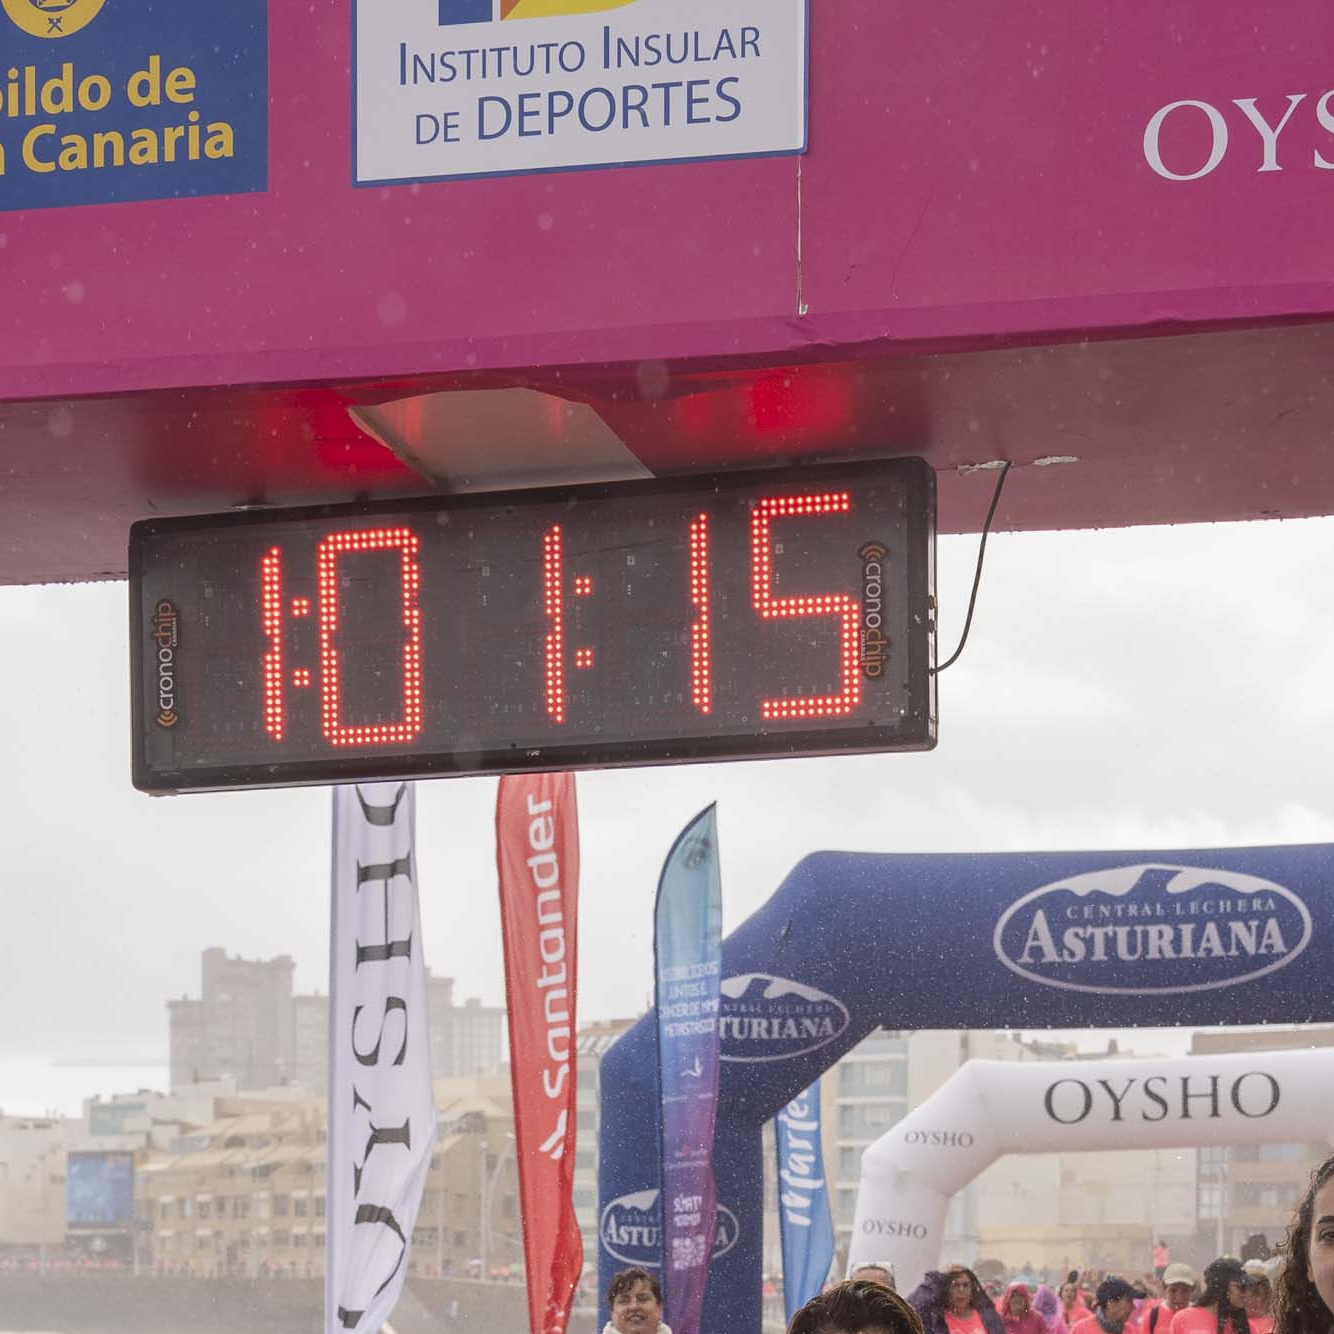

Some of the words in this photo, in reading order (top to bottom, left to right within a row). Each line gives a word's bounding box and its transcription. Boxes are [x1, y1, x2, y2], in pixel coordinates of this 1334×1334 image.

[127, 55, 196, 107] de
[400, 41, 585, 85] INSTITUTO
[603, 26, 761, 69] INSULAR
[415, 112, 460, 145] DE
[478, 76, 742, 140] DEPORTES
[22, 111, 234, 173] Canaria
[863, 562, 887, 677] cronochip
[155, 602, 176, 710] cronochip
[1019, 909, 1288, 963] ASTURIANA
[1067, 903, 1164, 919] CENTRAL
[1175, 898, 1275, 915] LECHERA
[528, 795, 571, 1098] Santander
[1044, 1072, 1280, 1124] OYSHO
[904, 1130, 974, 1149] OYSHO
[862, 1219, 928, 1240] OYSHO
